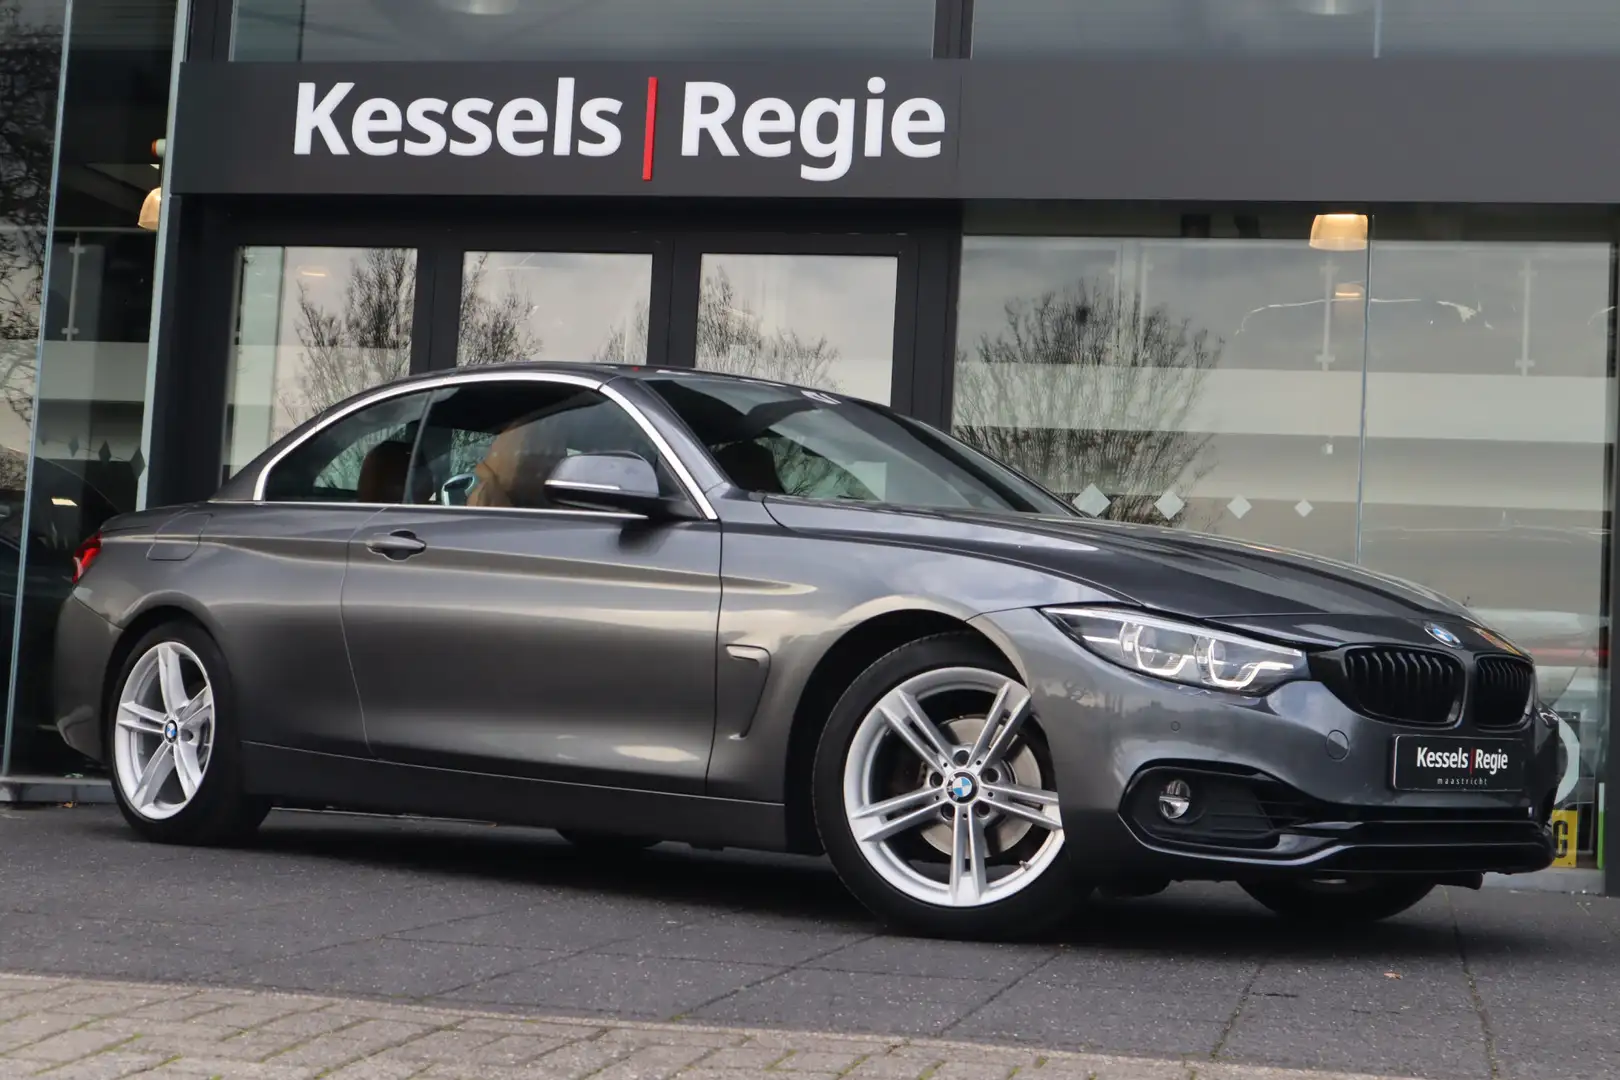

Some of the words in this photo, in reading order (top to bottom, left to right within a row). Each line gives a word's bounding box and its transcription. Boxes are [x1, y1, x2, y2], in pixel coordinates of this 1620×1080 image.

[294, 77, 623, 157] Kessels
[682, 77, 946, 181] Regie
[1416, 746, 1469, 769] Kessels
[1475, 748, 1508, 775] Regie
[1437, 777, 1488, 786] maastricht
